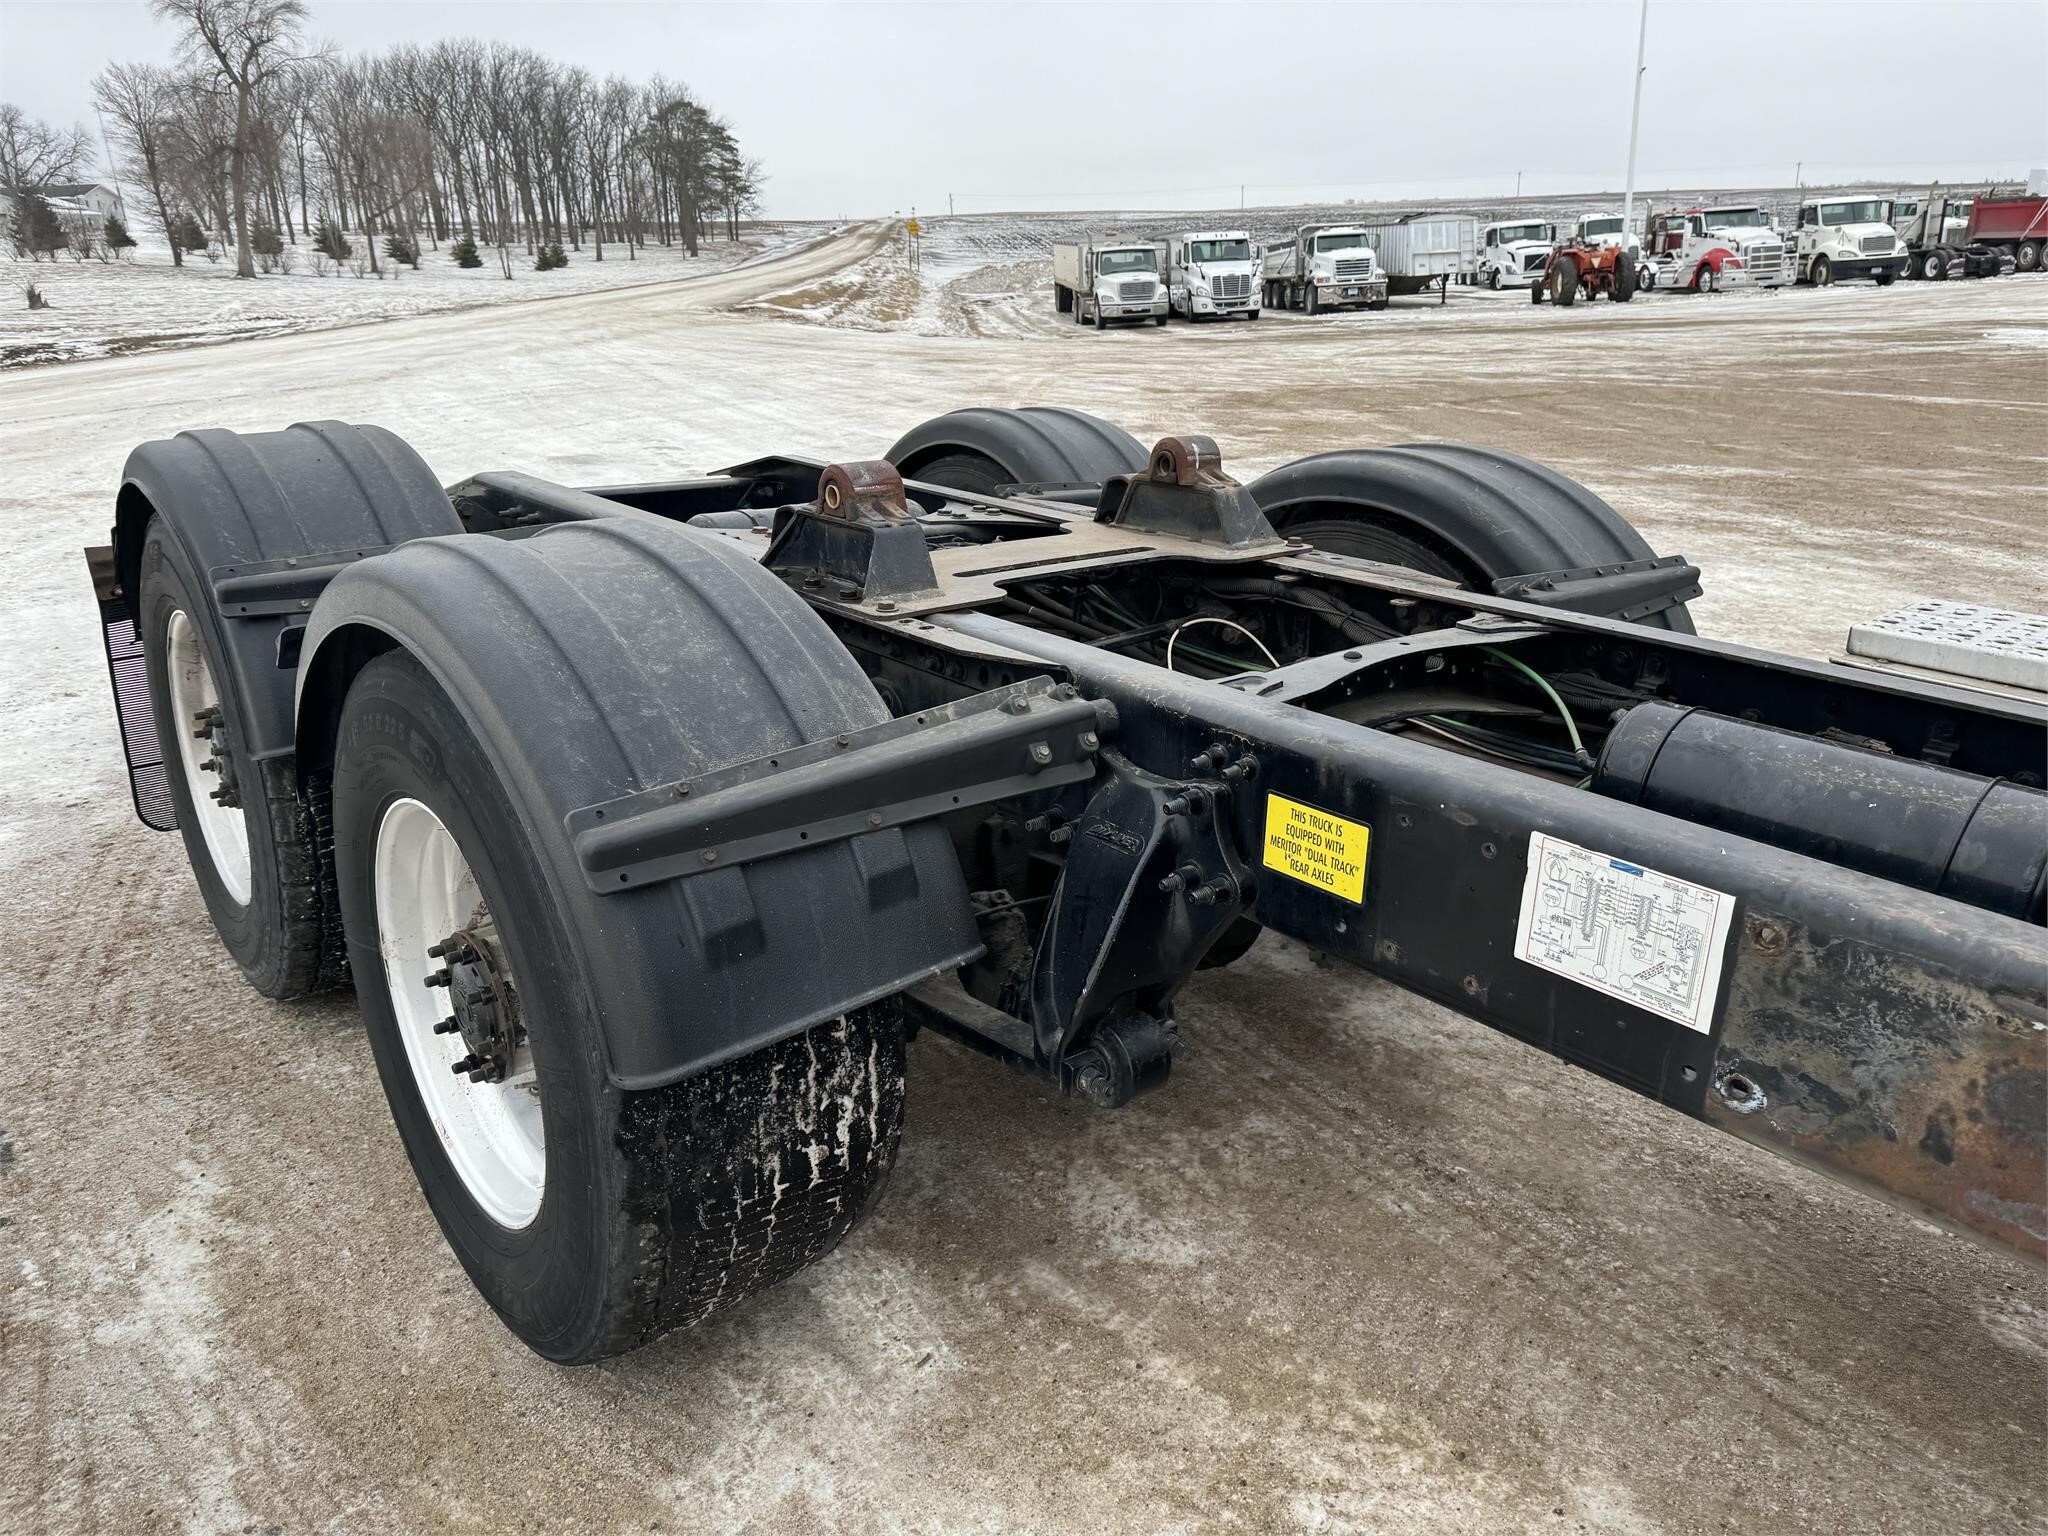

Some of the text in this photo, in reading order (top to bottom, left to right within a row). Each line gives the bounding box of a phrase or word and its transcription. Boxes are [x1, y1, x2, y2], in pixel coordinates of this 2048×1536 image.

[1290, 808, 1343, 837] THIS TRUCK IS
[1285, 823, 1345, 855] EQUIPPED WITH
[1270, 834, 1360, 877] MERITOR "DUAL TRACK"
[1290, 859, 1334, 886] REAR AXLES
